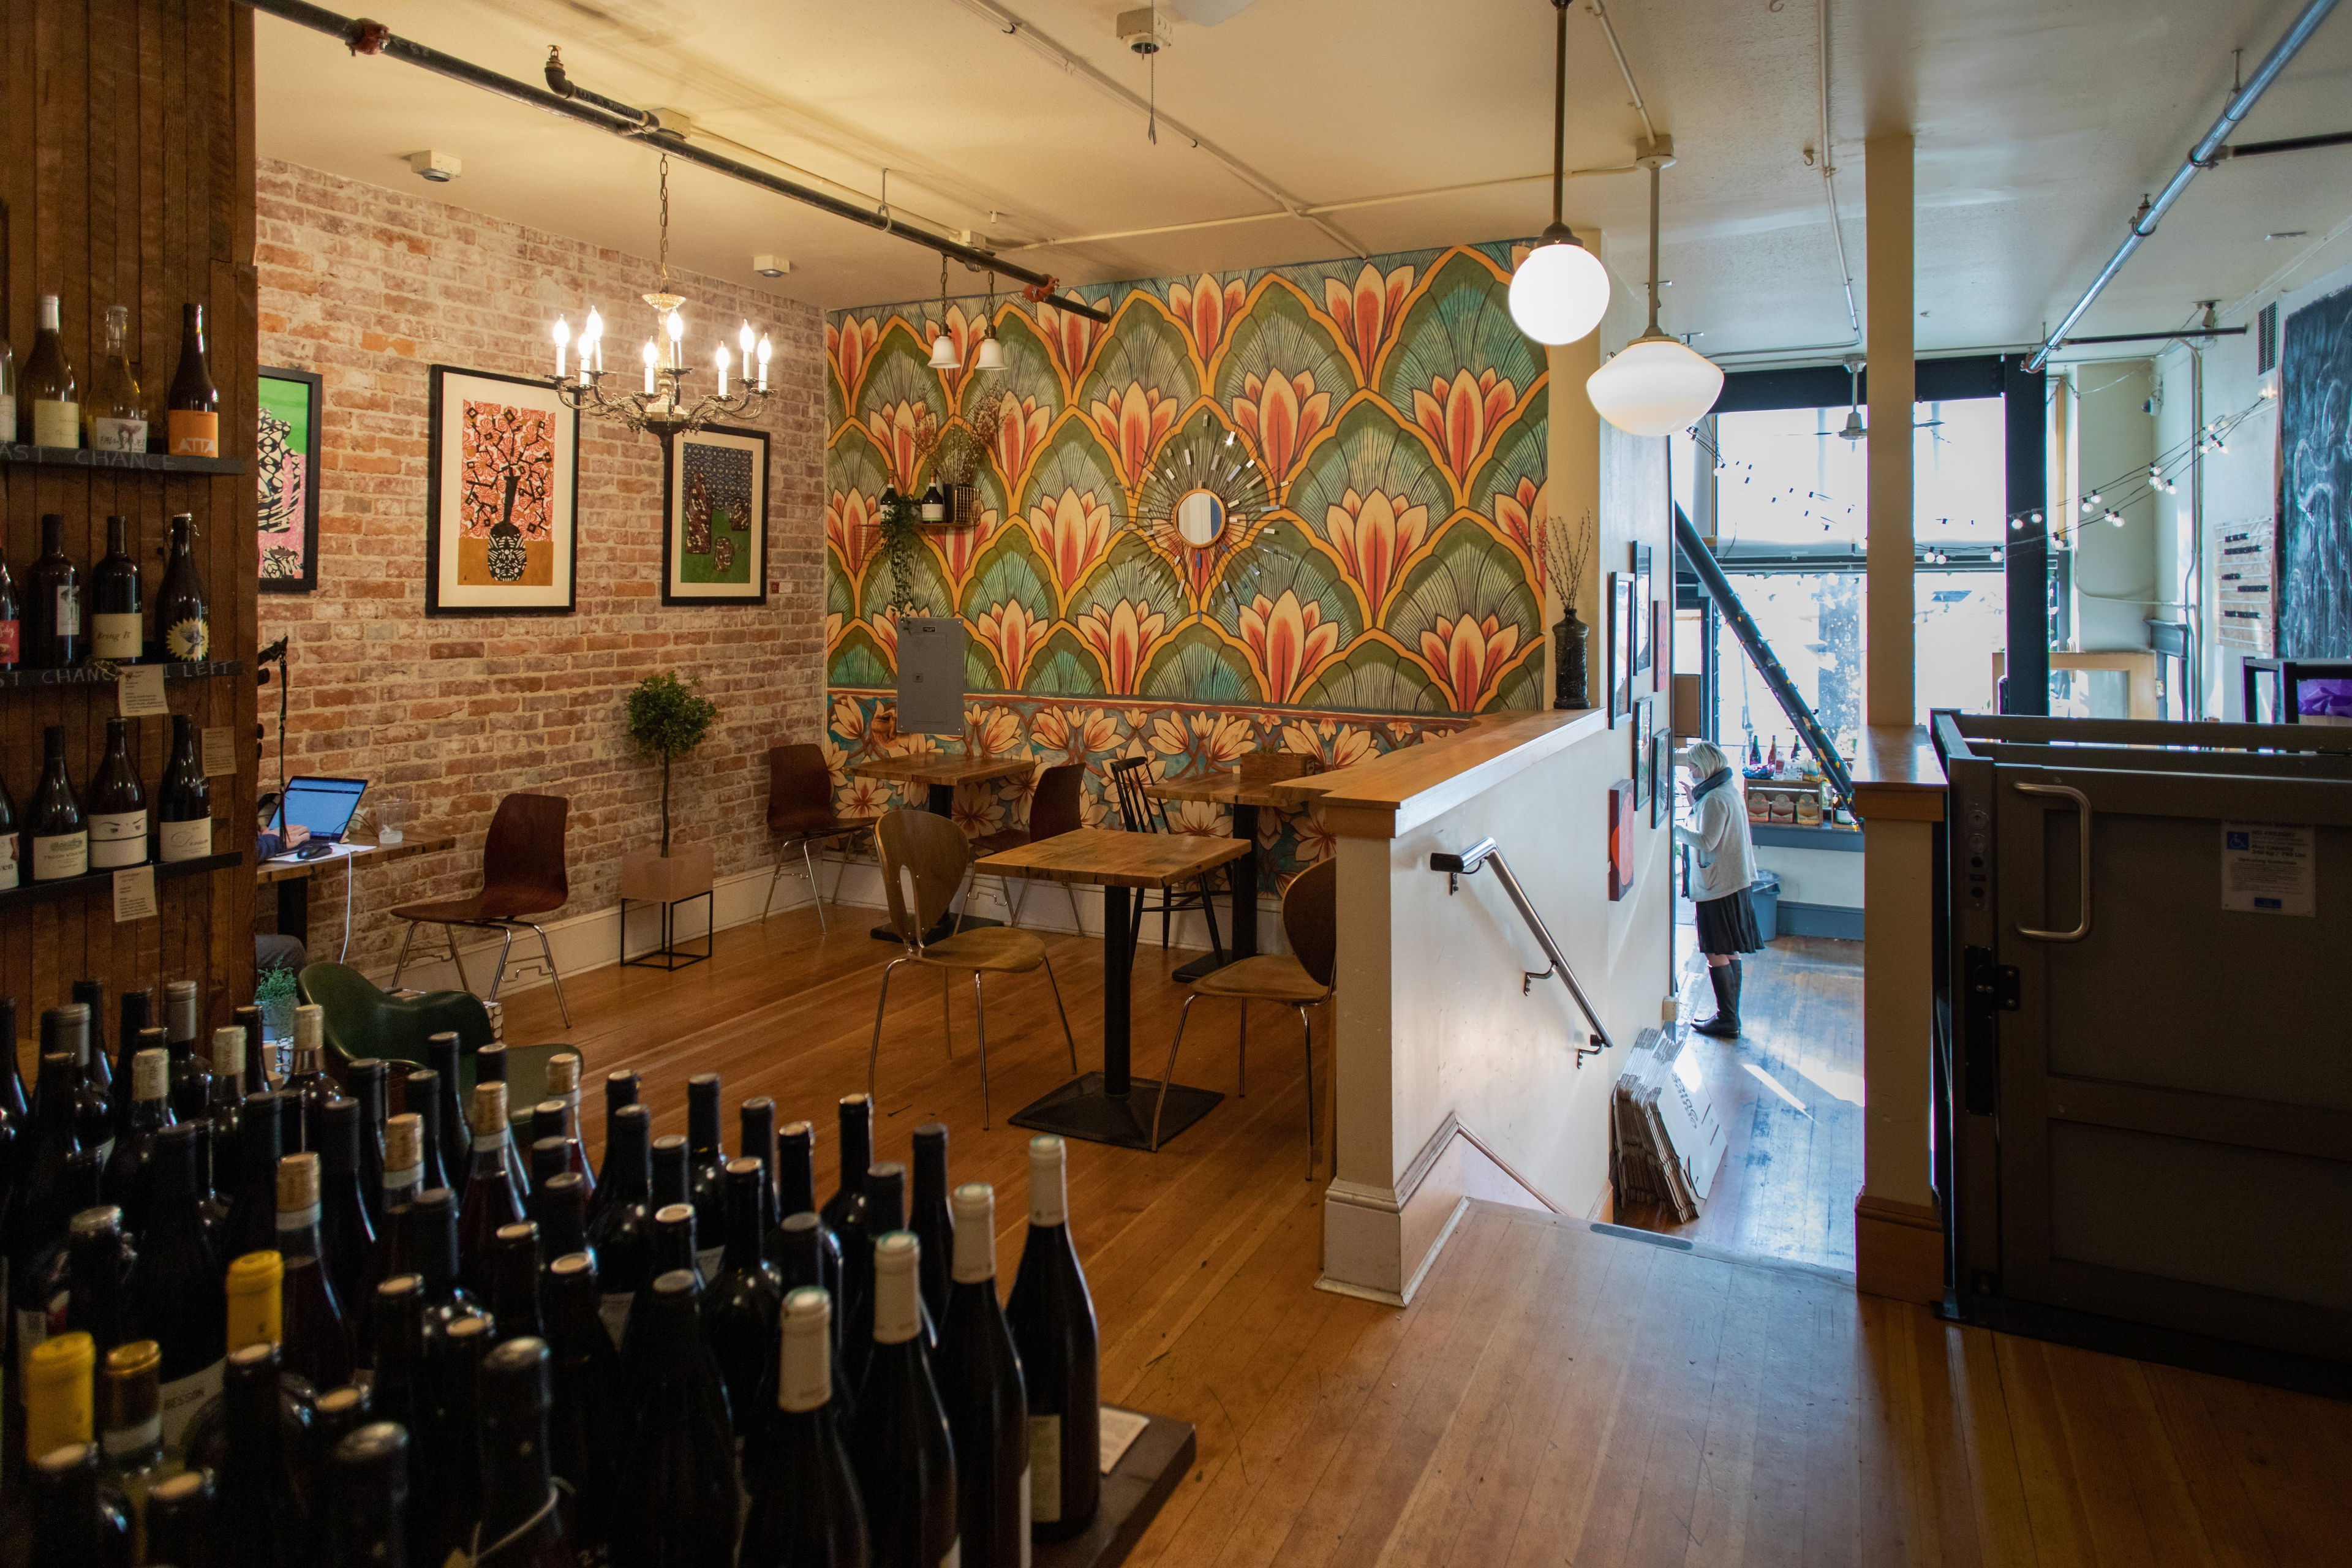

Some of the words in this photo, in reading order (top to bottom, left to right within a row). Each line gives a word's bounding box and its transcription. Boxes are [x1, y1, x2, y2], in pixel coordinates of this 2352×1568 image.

[179, 437, 215, 453] ATTA
[74, 450, 176, 470] CHANCE
[97, 631, 121, 642] Bring
[183, 662, 232, 677] LEFT
